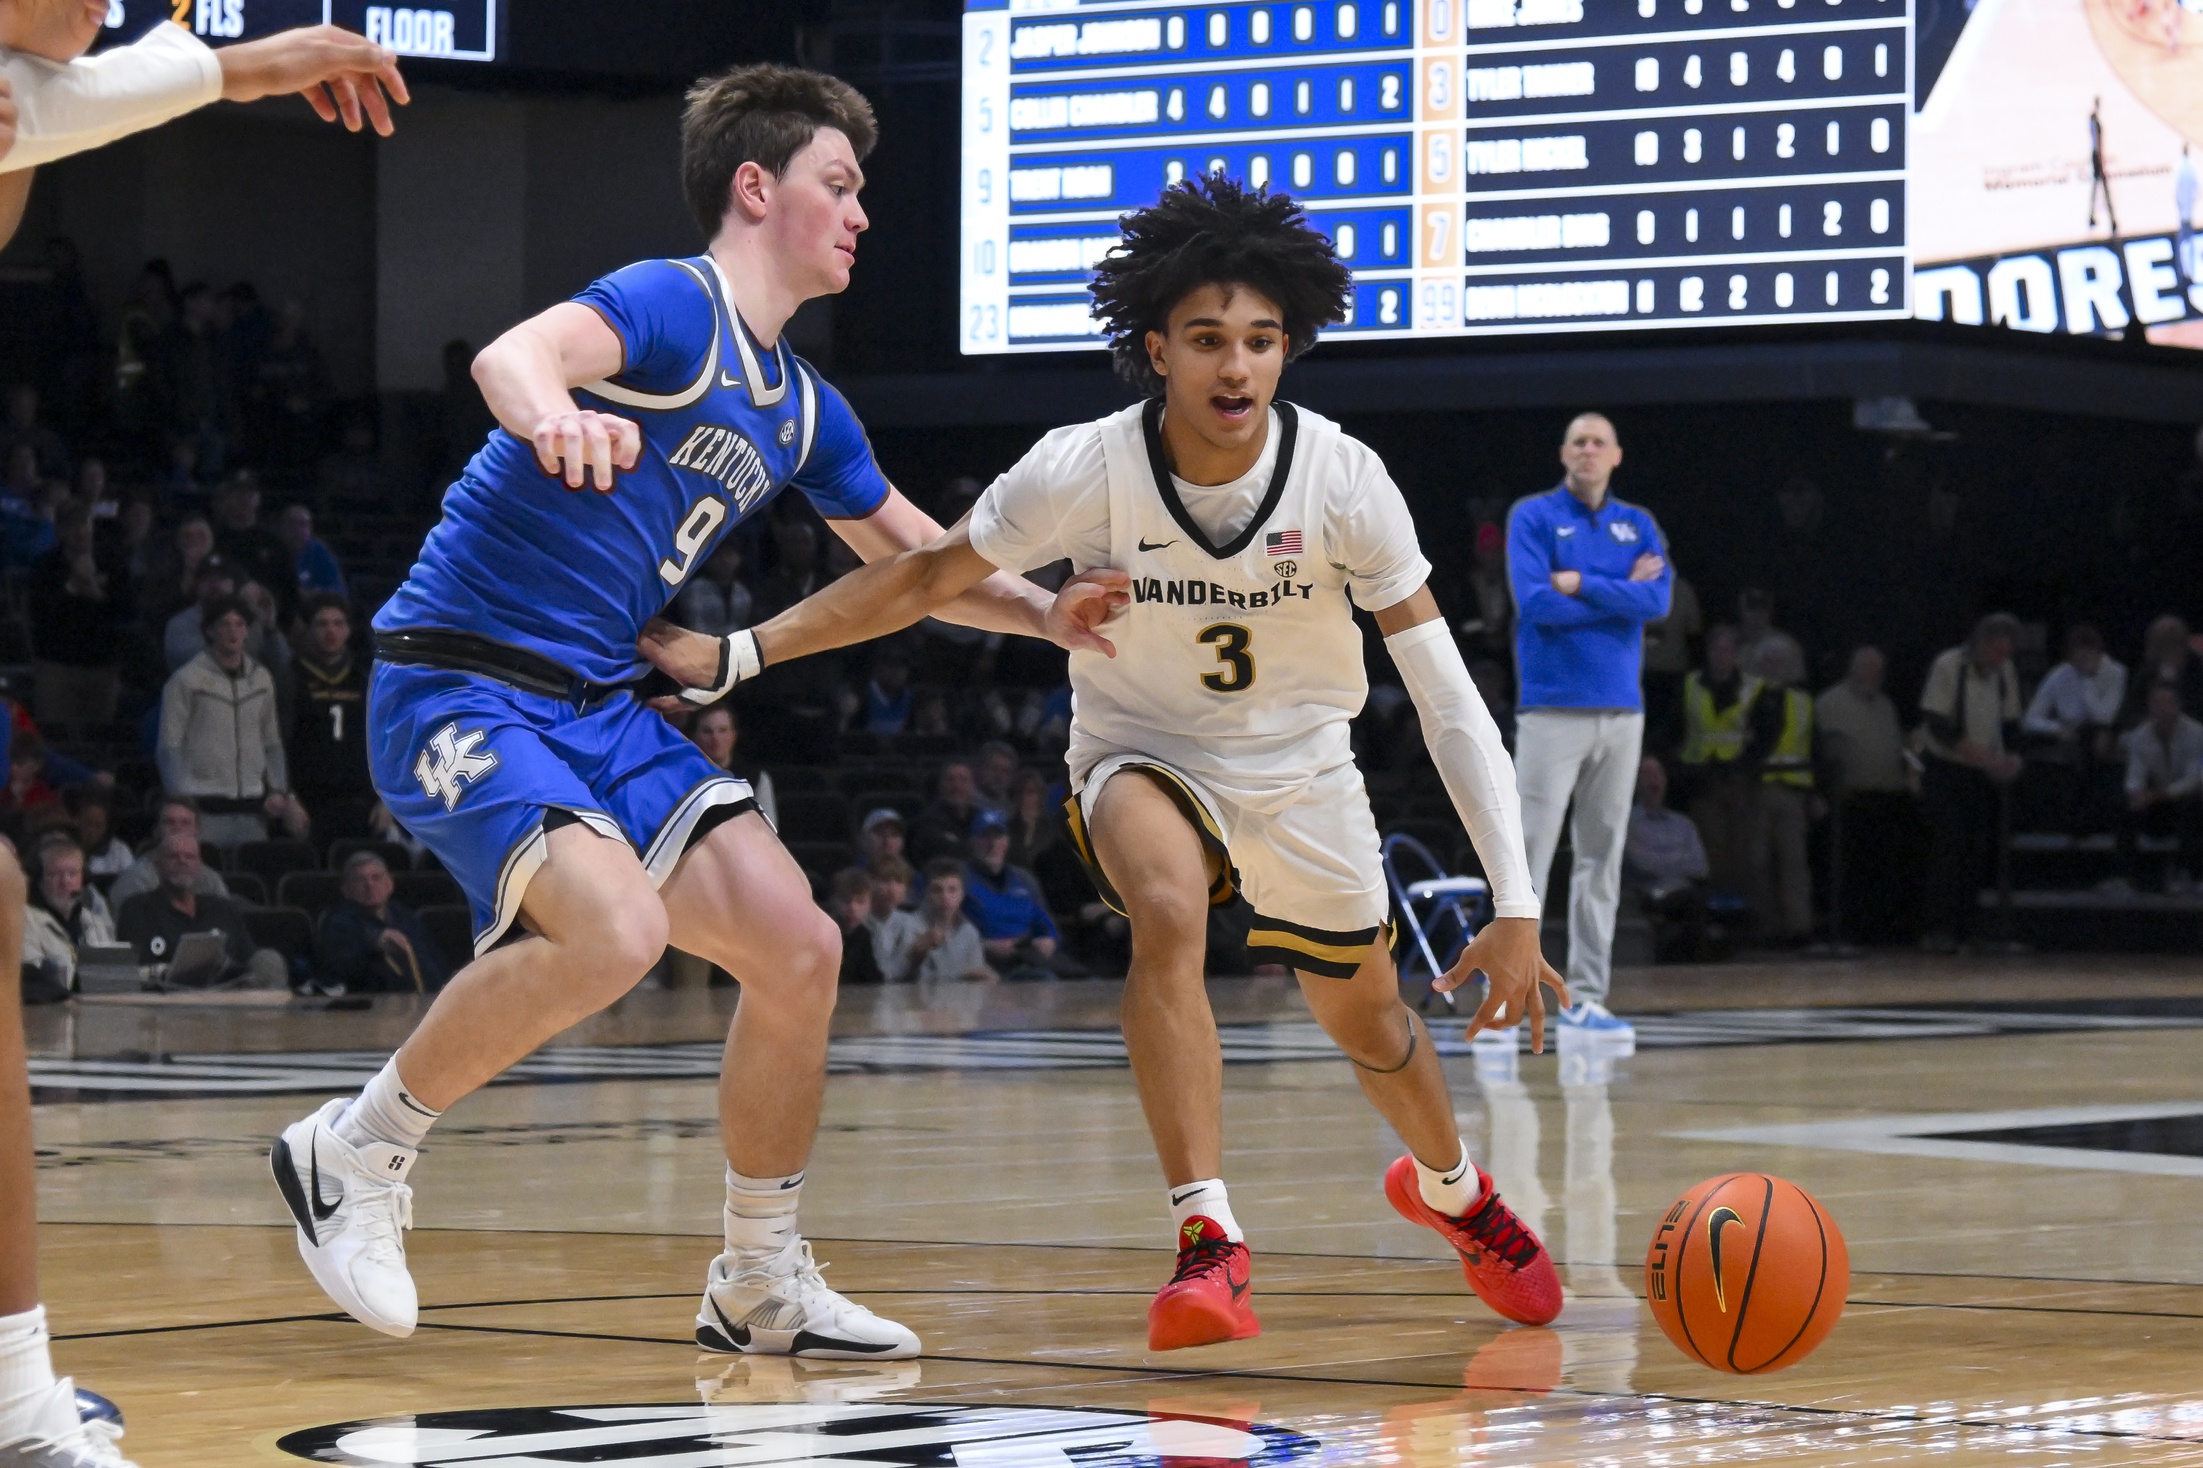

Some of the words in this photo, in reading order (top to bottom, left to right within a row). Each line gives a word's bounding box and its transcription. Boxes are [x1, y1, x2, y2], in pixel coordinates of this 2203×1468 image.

[196, 0, 245, 38] FLS
[366, 6, 455, 53] FLOOR
[978, 28, 993, 67] 2
[1431, 64, 1450, 108] 3
[1683, 54, 1703, 89] 4
[1776, 48, 1796, 83] 4
[978, 96, 993, 134] 5
[1166, 89, 1184, 121] 4
[1209, 86, 1226, 118] 4
[1381, 75, 1399, 109] 2
[1776, 123, 1796, 159] 2
[977, 167, 993, 205] 9
[1429, 214, 1449, 257] 7
[1822, 200, 1842, 237] 2
[973, 238, 996, 276] 10
[970, 303, 1000, 341] 23
[1380, 290, 1398, 324] 2
[1422, 281, 1455, 324] 99
[1728, 274, 1748, 310] 2
[1870, 268, 1890, 305] 2
[669, 425, 771, 514] KENTUCKY
[660, 496, 726, 586] 9
[1132, 576, 1314, 610] VANDERBILT
[1274, 560, 1298, 578] SEC
[1196, 622, 1257, 693] 3
[329, 704, 344, 741] 1
[1652, 1199, 1692, 1302] ELITE
